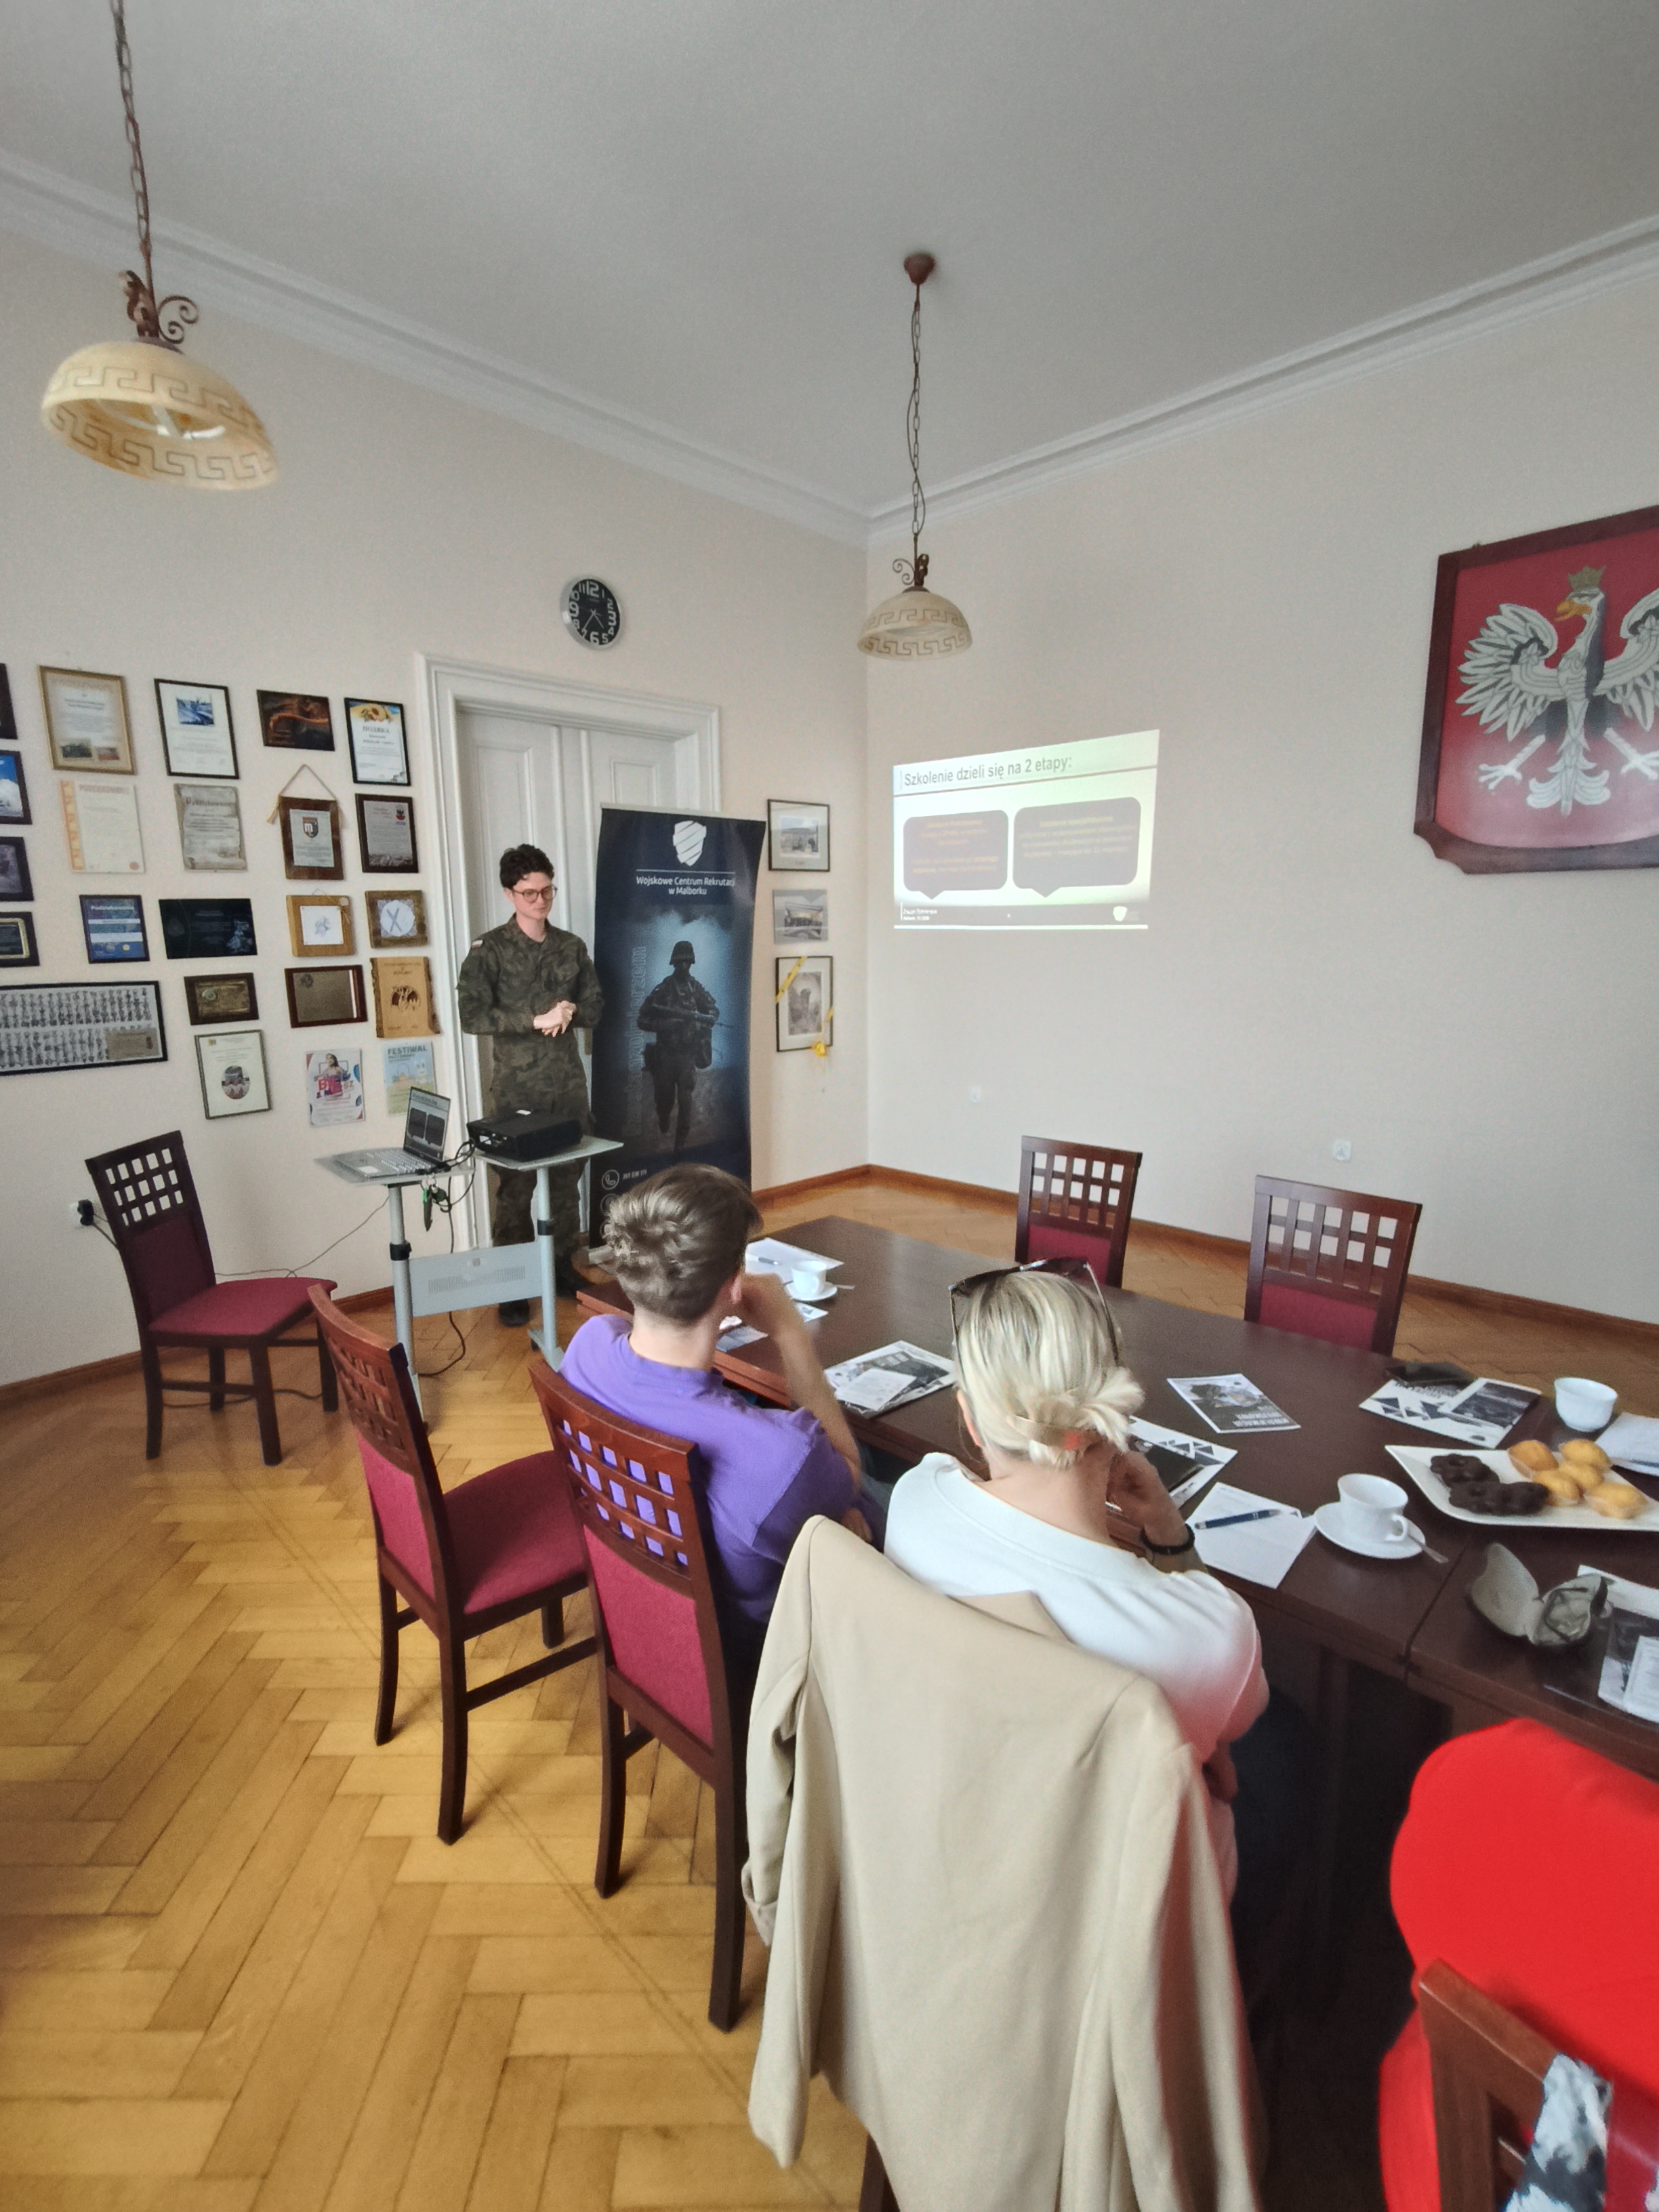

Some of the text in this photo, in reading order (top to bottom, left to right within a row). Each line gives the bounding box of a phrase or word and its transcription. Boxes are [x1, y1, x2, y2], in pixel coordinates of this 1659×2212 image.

[578, 583, 586, 594] 11
[586, 581, 600, 598] 12
[601, 588, 605, 599] 1
[569, 600, 579, 617] 9
[607, 598, 614, 610] 2
[607, 610, 617, 626] 3
[607, 626, 615, 636] 4
[590, 631, 600, 645] 6
[601, 632, 609, 644] 5
[904, 756, 1072, 787] Szkolenie dzieli się na 2 etapy:
[636, 875, 673, 886] Wojskowe
[674, 876, 703, 886] Centrum
[676, 886, 708, 896] Malborku
[387, 1045, 428, 1055] FESTIWAL
